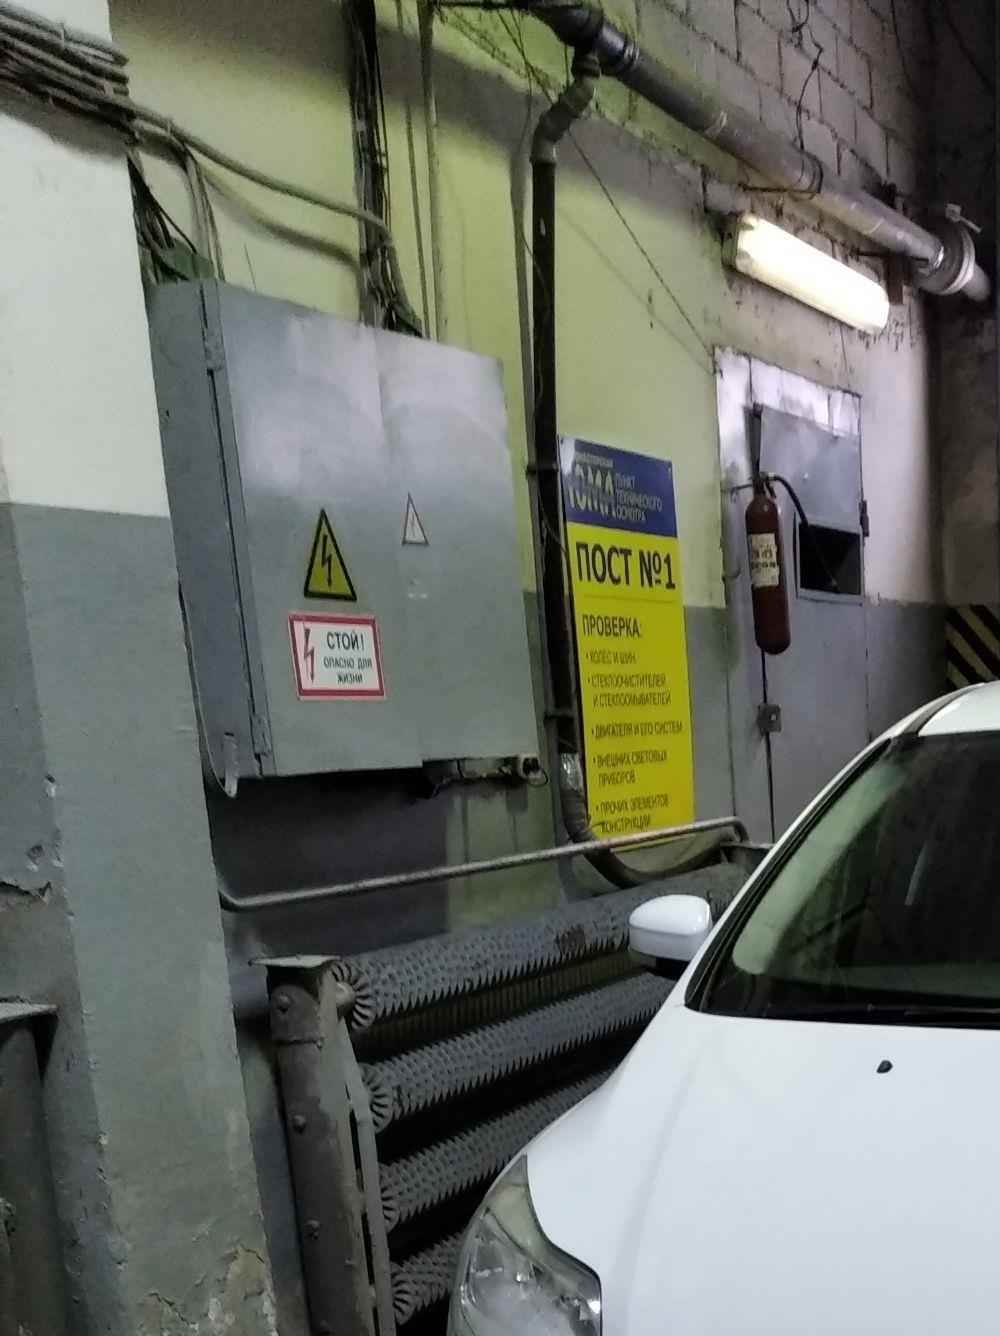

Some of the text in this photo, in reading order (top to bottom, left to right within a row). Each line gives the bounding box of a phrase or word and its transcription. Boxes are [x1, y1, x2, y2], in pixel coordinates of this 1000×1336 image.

[576, 541, 676, 590] ПОСТ №1
[326, 630, 364, 651] СТОЙ!
[324, 656, 373, 671] ОПАСНО ДЛЯ
[337, 673, 363, 684] ЖИЗНИ
